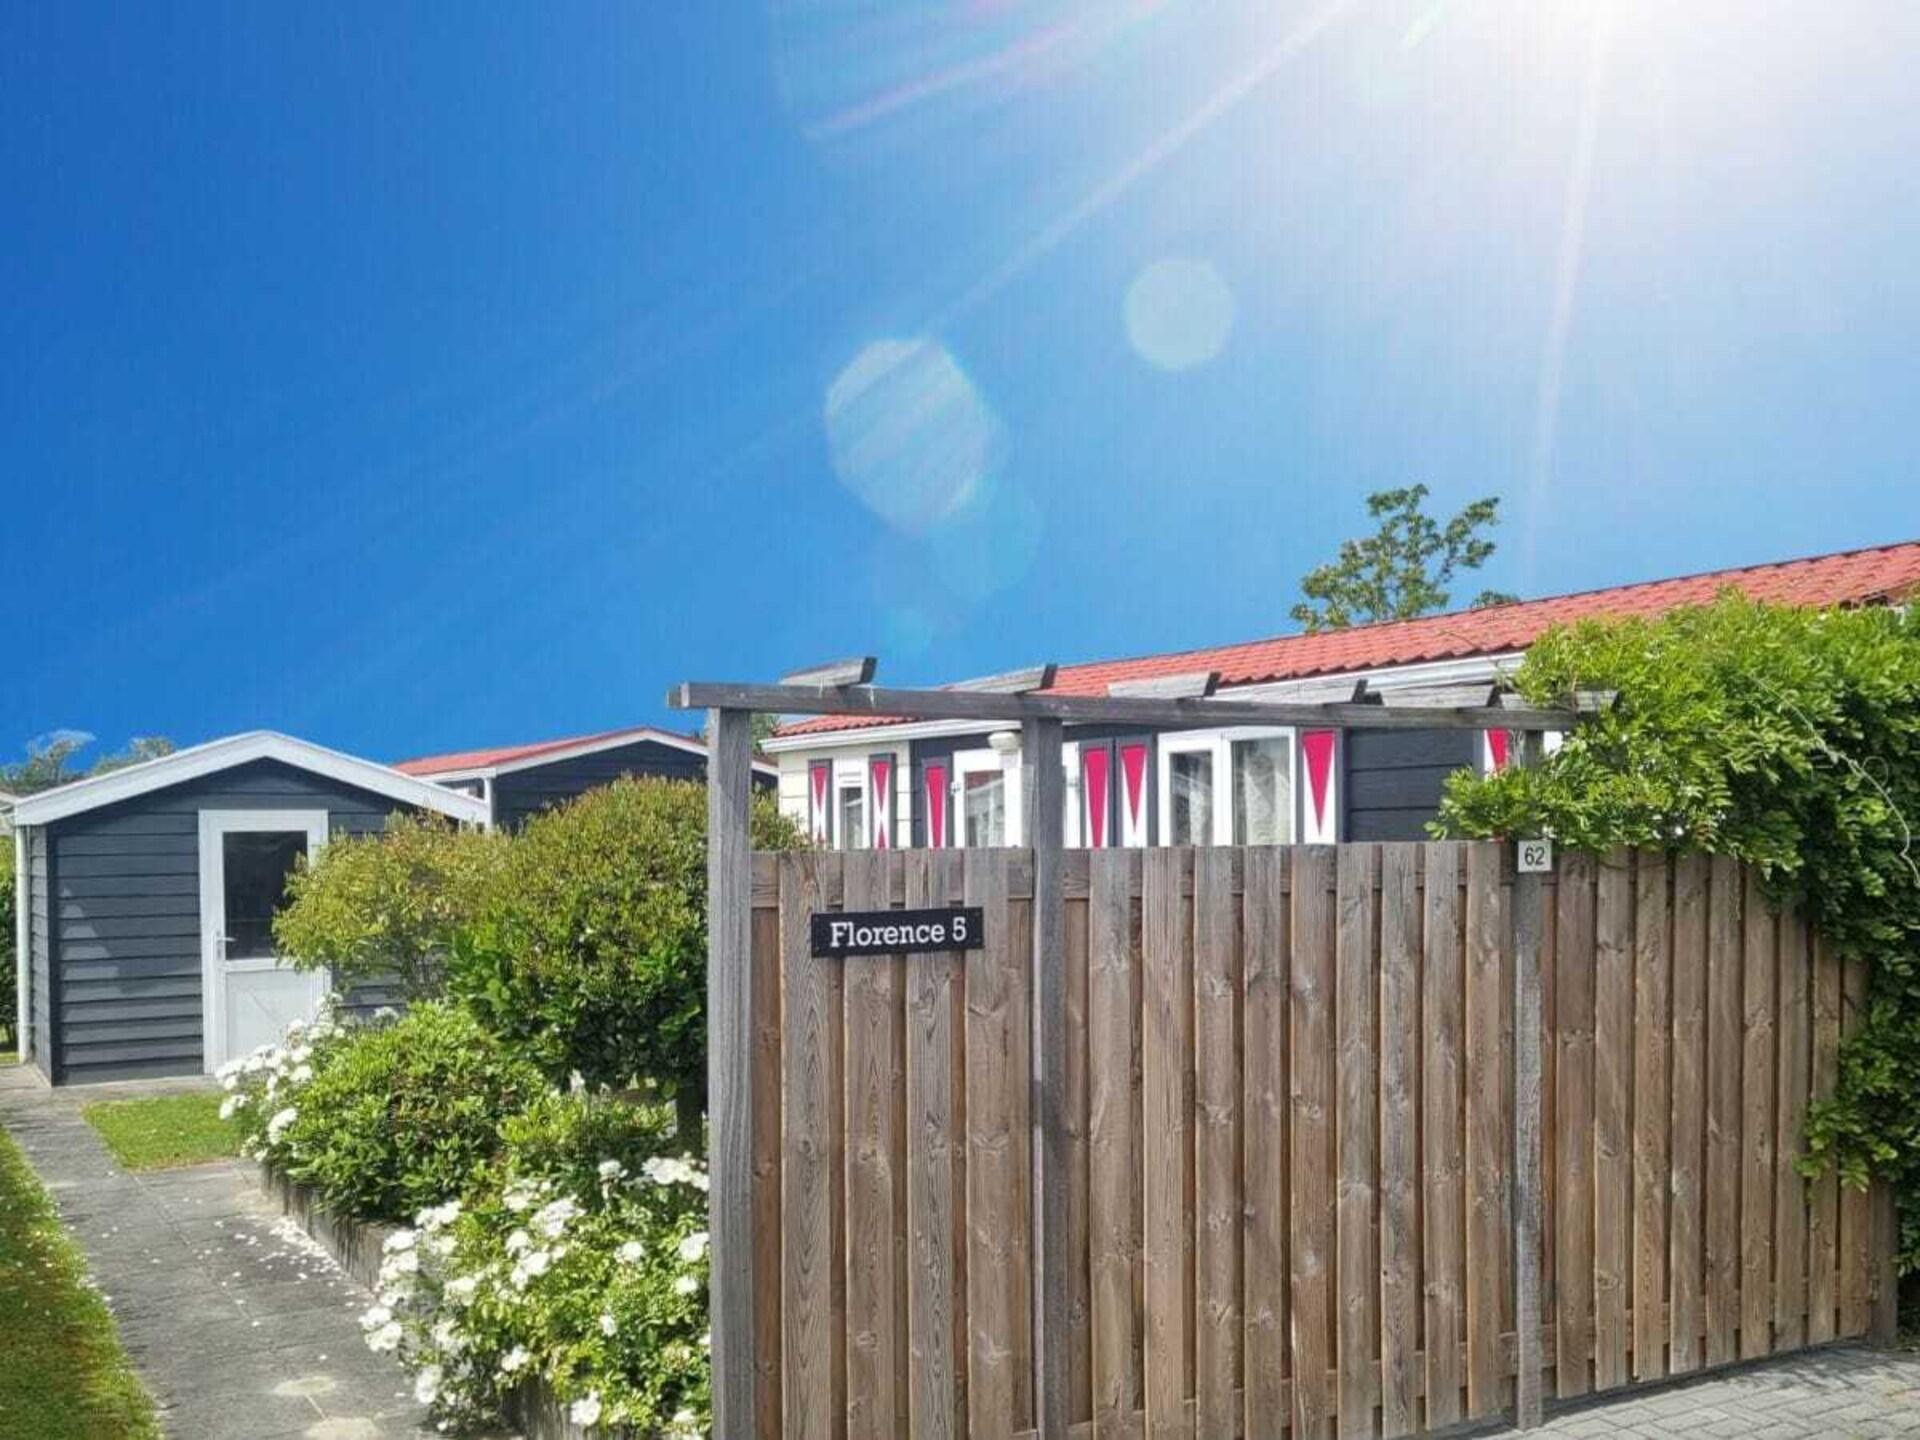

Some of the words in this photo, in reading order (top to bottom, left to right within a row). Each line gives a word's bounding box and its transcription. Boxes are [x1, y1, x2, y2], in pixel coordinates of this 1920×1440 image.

[1524, 846, 1545, 866] 62
[830, 922, 945, 947] Florence
[952, 916, 967, 942] 5
